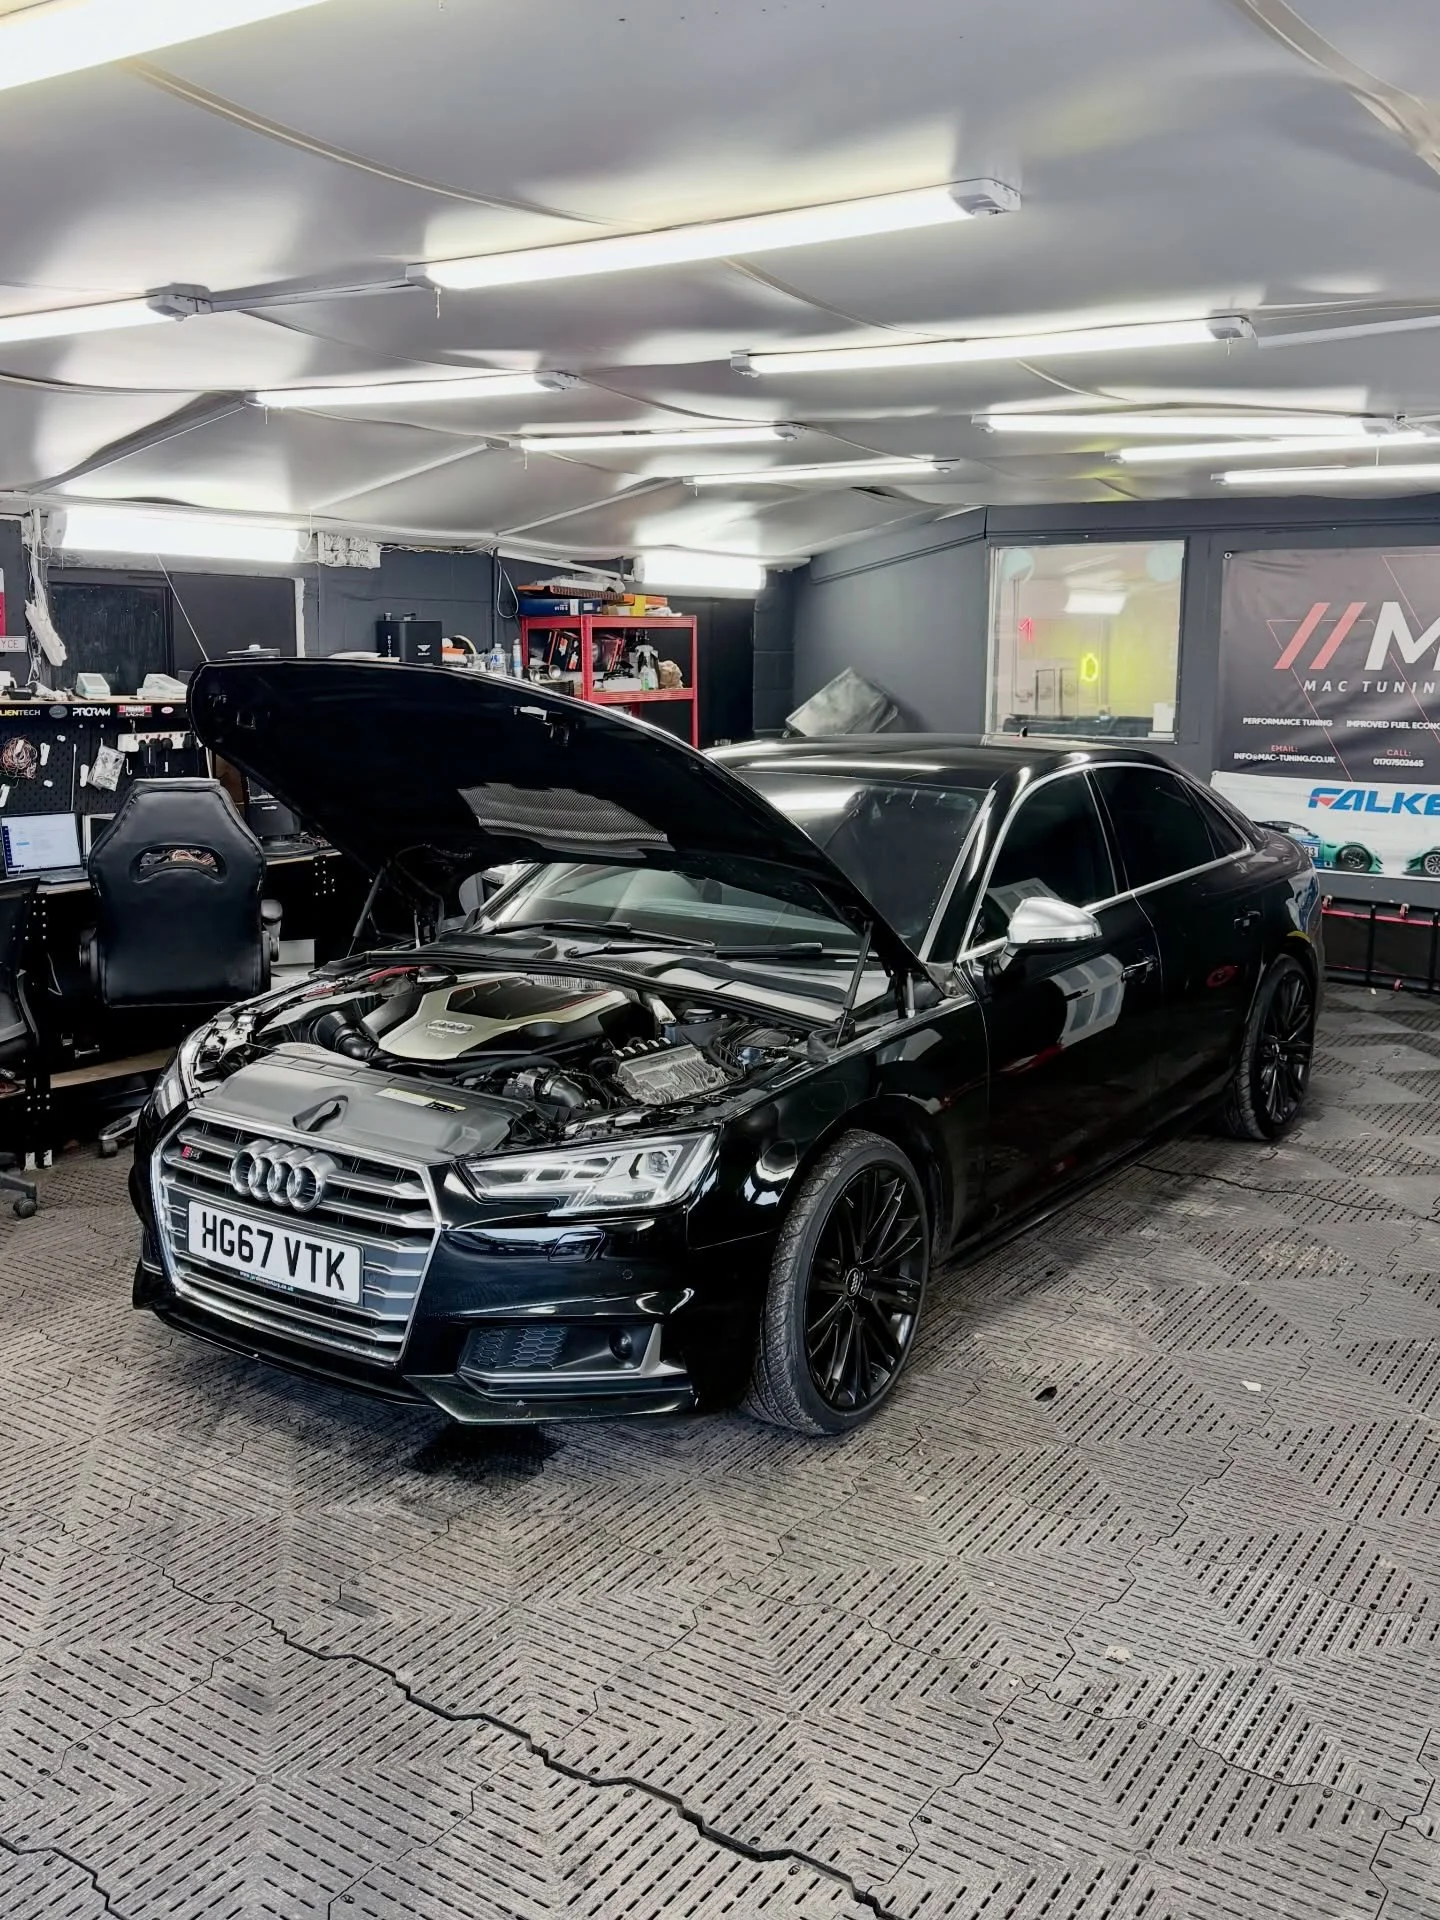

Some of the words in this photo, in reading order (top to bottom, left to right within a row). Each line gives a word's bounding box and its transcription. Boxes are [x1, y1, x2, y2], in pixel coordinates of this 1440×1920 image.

[1303, 680, 1348, 692] MAC
[1362, 681, 1436, 694] TUNIN
[72, 707, 111, 717] PRORAM
[1242, 717, 1301, 726] PERFORMANCE
[1302, 718, 1333, 727] TUNING
[1346, 719, 1389, 729] IMPROVED
[1390, 721, 1411, 729] FUEL
[1271, 744, 1298, 752] EMAIL:
[1386, 749, 1412, 757] CALL:
[1233, 752, 1336, 763] INFO@MAC-TUNING.CO.UK
[1308, 787, 1440, 816] FALKE
[203, 1211, 273, 1268] HG67
[285, 1237, 345, 1291] VTK
